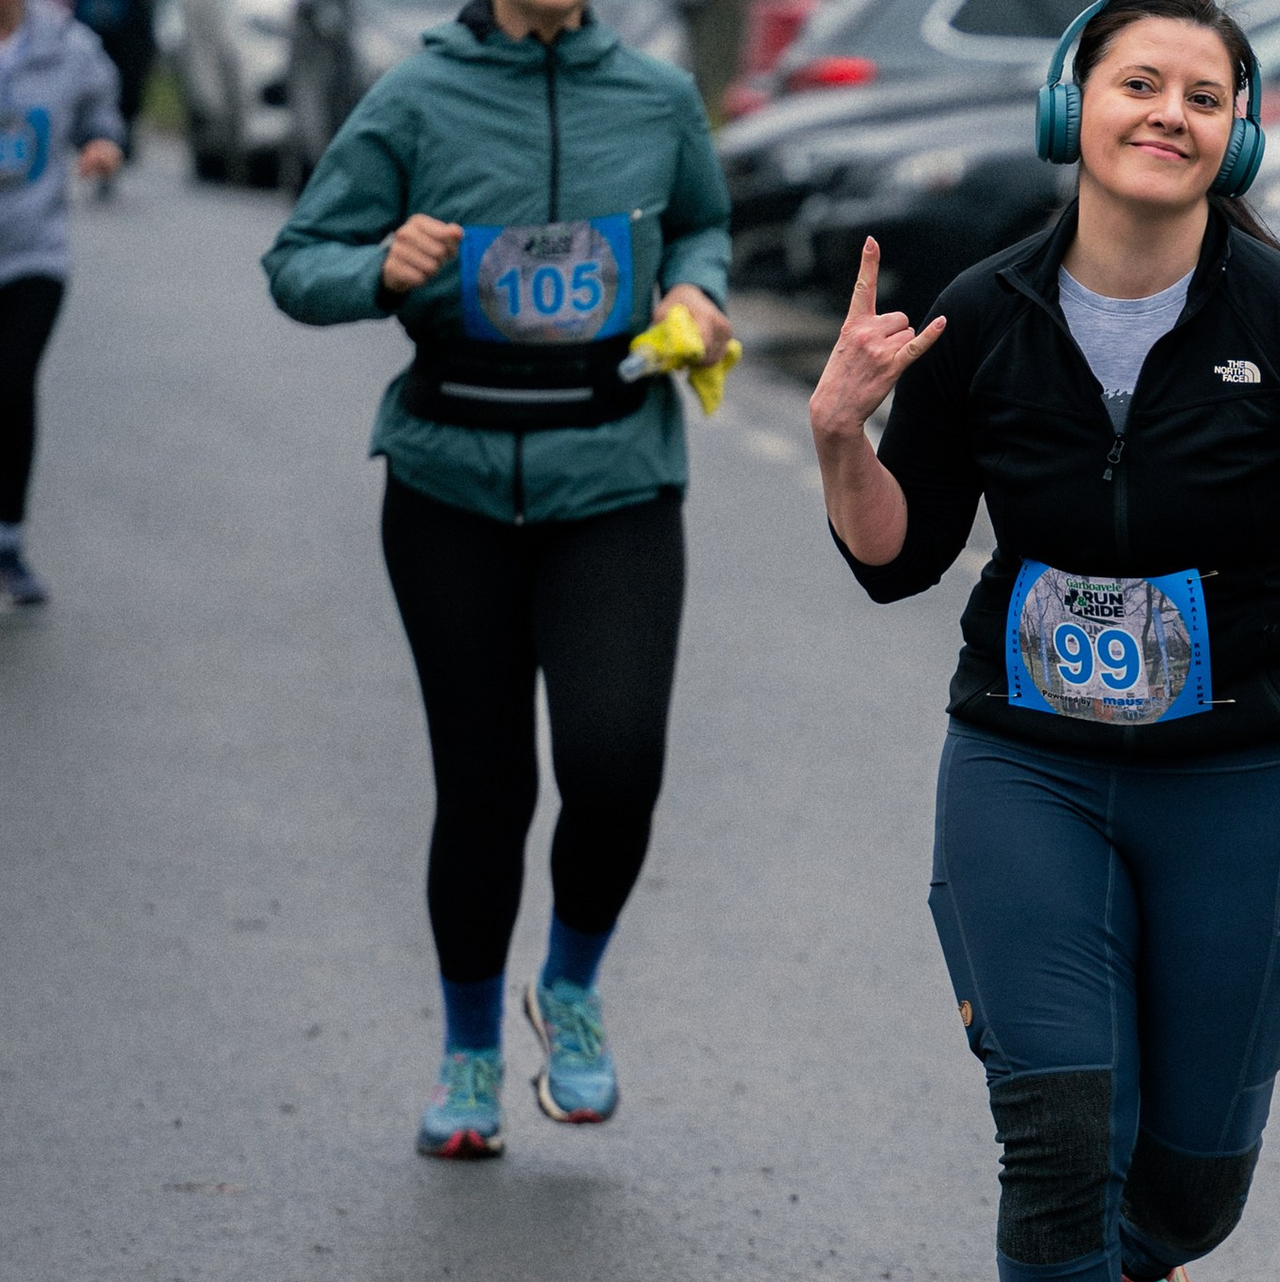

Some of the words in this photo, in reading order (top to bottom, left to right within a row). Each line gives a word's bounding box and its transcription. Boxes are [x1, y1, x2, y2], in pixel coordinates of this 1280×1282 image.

[496, 260, 603, 316] 105
[1214, 366, 1245, 375] NORTH
[1227, 360, 1245, 368] THE
[1222, 374, 1245, 383] FACE
[1077, 596, 1087, 606] &
[1082, 590, 1124, 606] RUN
[1083, 604, 1125, 618] RIDE
[1188, 587, 1199, 631] TRAIL
[1054, 623, 1141, 690] 99
[1042, 689, 1079, 704] Powered
[1081, 696, 1092, 706] by
[1103, 697, 1144, 706] maus
